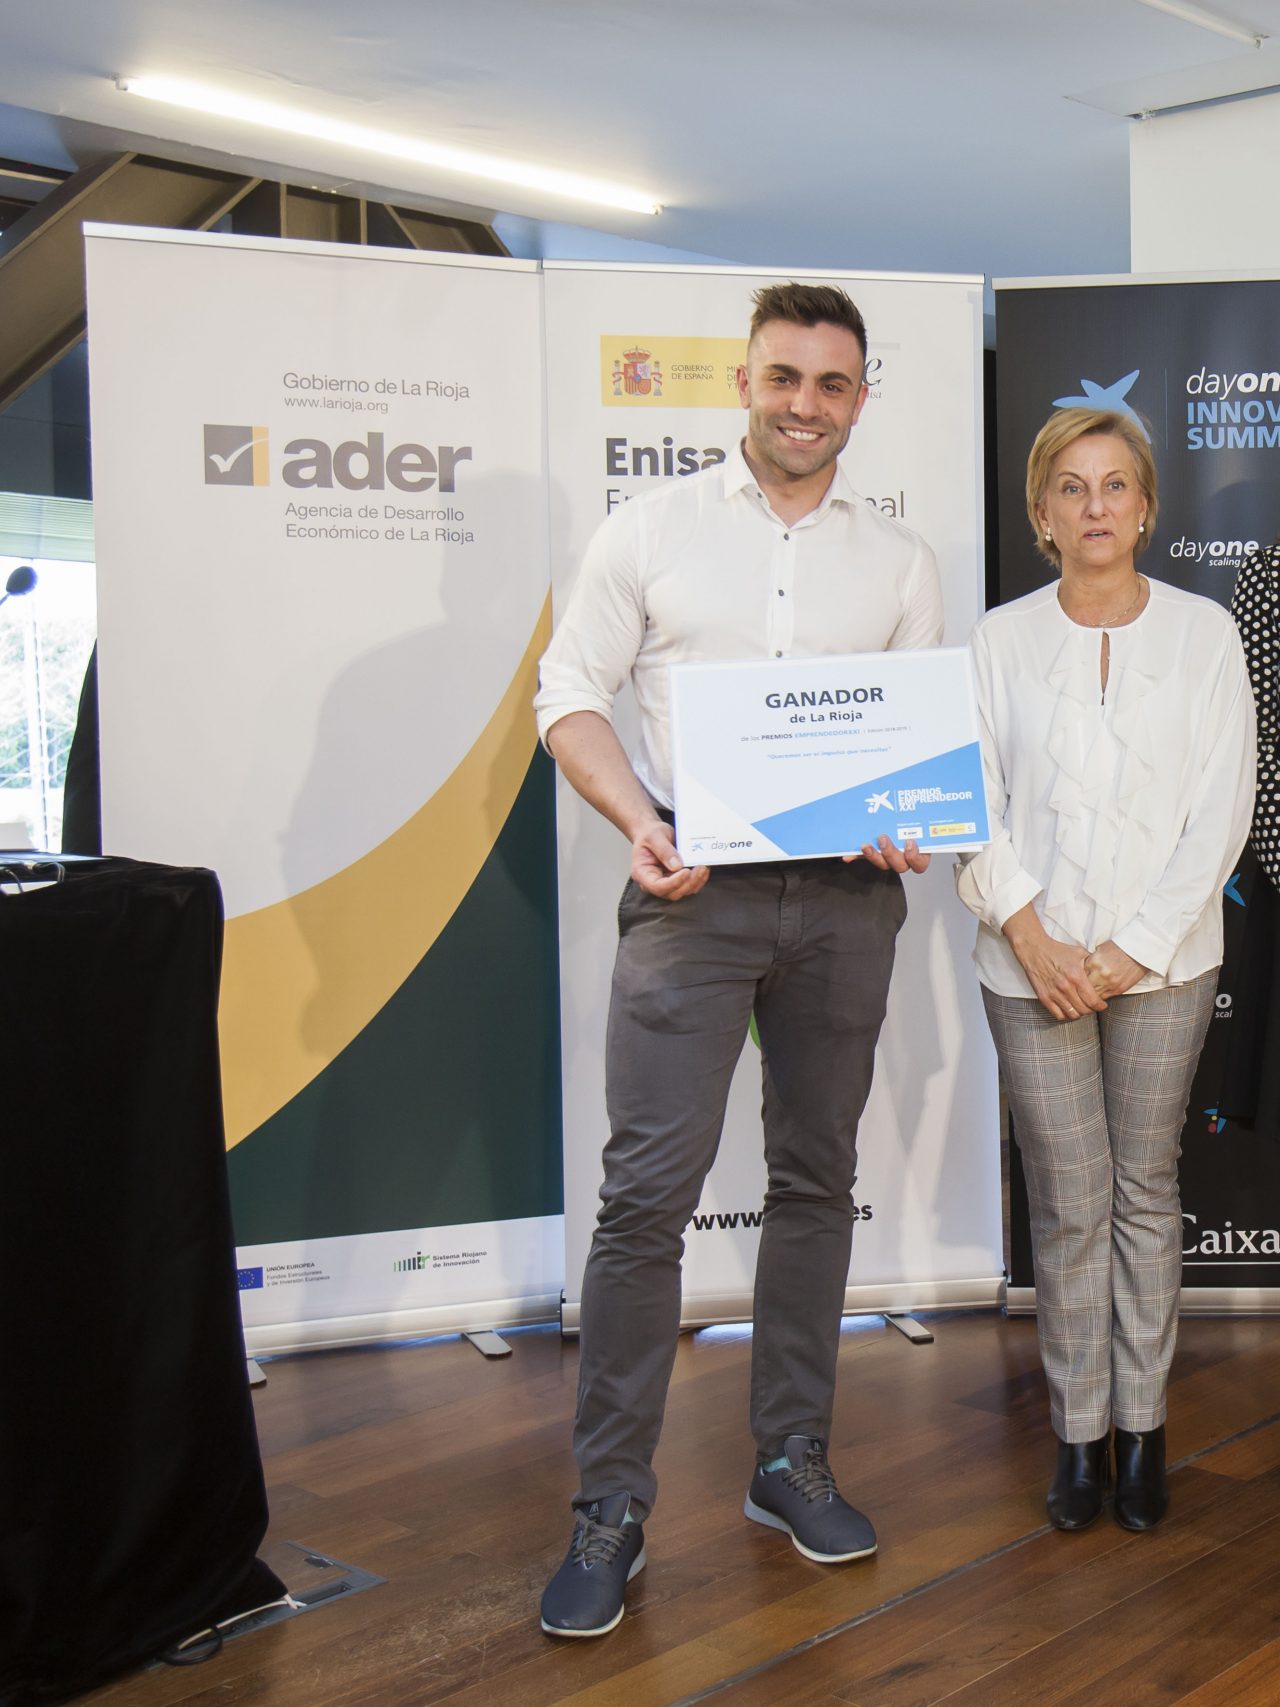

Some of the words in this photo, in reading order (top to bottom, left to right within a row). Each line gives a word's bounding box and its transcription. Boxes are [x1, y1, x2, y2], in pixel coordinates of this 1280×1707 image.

[671, 364, 714, 373] GOBIERNO
[671, 372, 684, 380] DE
[685, 372, 714, 380] ESPAÑA
[282, 372, 370, 394] Gobierno
[374, 378, 398, 395] de
[401, 379, 422, 396] La
[426, 381, 470, 402] Rioja
[283, 396, 389, 415] www.larioja.org
[282, 430, 473, 494] ader
[285, 502, 353, 523] Agencia
[357, 504, 379, 520] de
[383, 505, 465, 522] Desarrollo
[286, 523, 380, 542] Económico
[384, 526, 405, 542] de
[410, 527, 430, 543] La
[435, 528, 475, 546] Rioja
[1169, 536, 1260, 562] dayone
[1208, 557, 1241, 568] scaling
[765, 686, 885, 709] GANADOR
[789, 712, 806, 724] de
[810, 711, 826, 723] La
[829, 709, 864, 723] Rioja
[761, 733, 793, 741] PREMIOS
[711, 840, 753, 851] dayone
[432, 1253, 460, 1261] Sistema
[461, 1251, 488, 1259] Riojano
[286, 1262, 316, 1270] EUROPEA
[443, 1259, 480, 1267] Innovación
